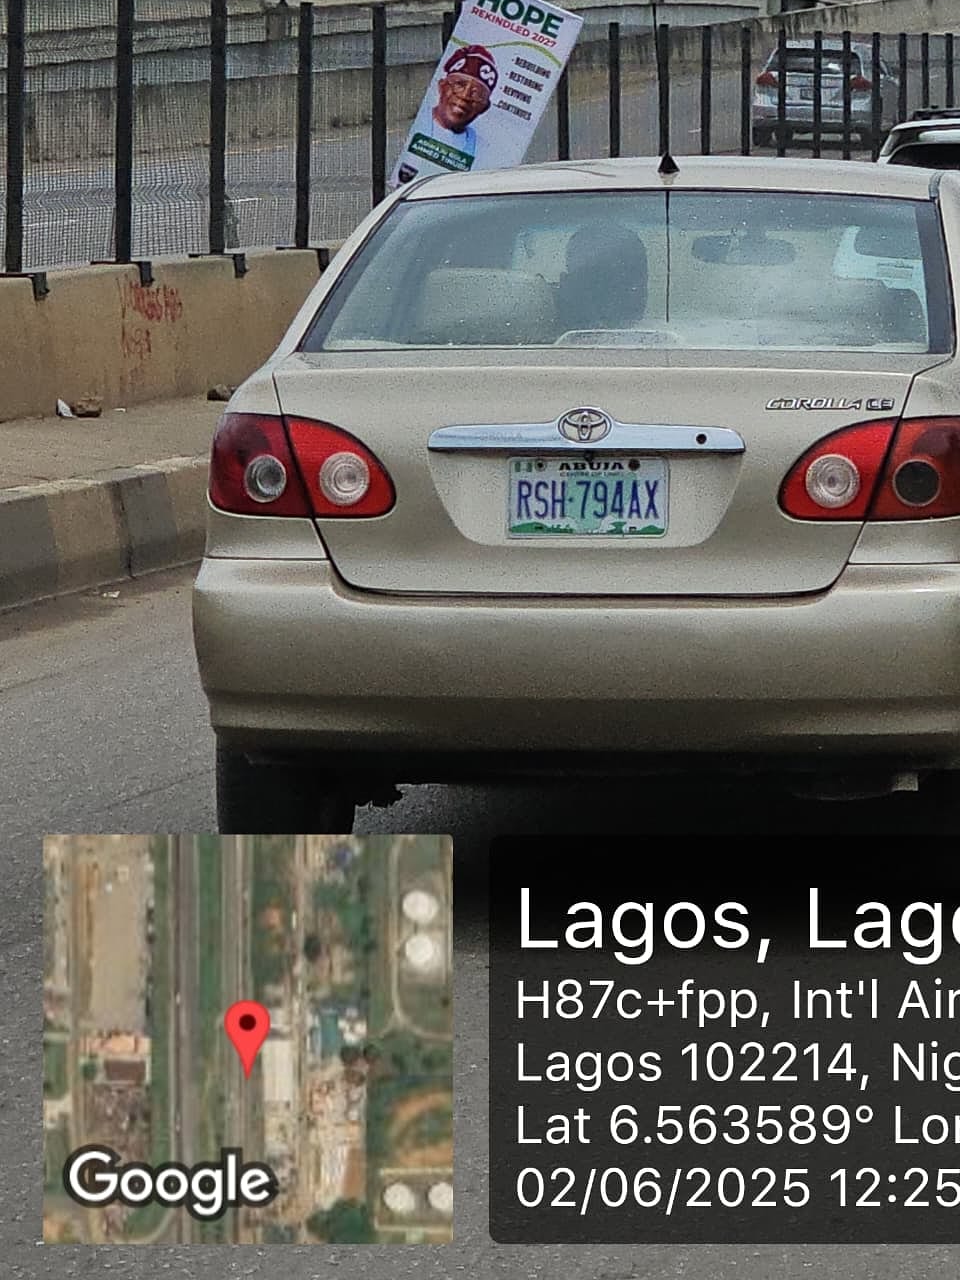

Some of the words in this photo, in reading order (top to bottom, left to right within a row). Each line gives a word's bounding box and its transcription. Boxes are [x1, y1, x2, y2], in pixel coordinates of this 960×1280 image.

[471, 6, 530, 37] REKINDLED
[531, 32, 557, 48] 2027
[765, 397, 862, 410] COROLLA
[559, 462, 624, 471] ABUJA
